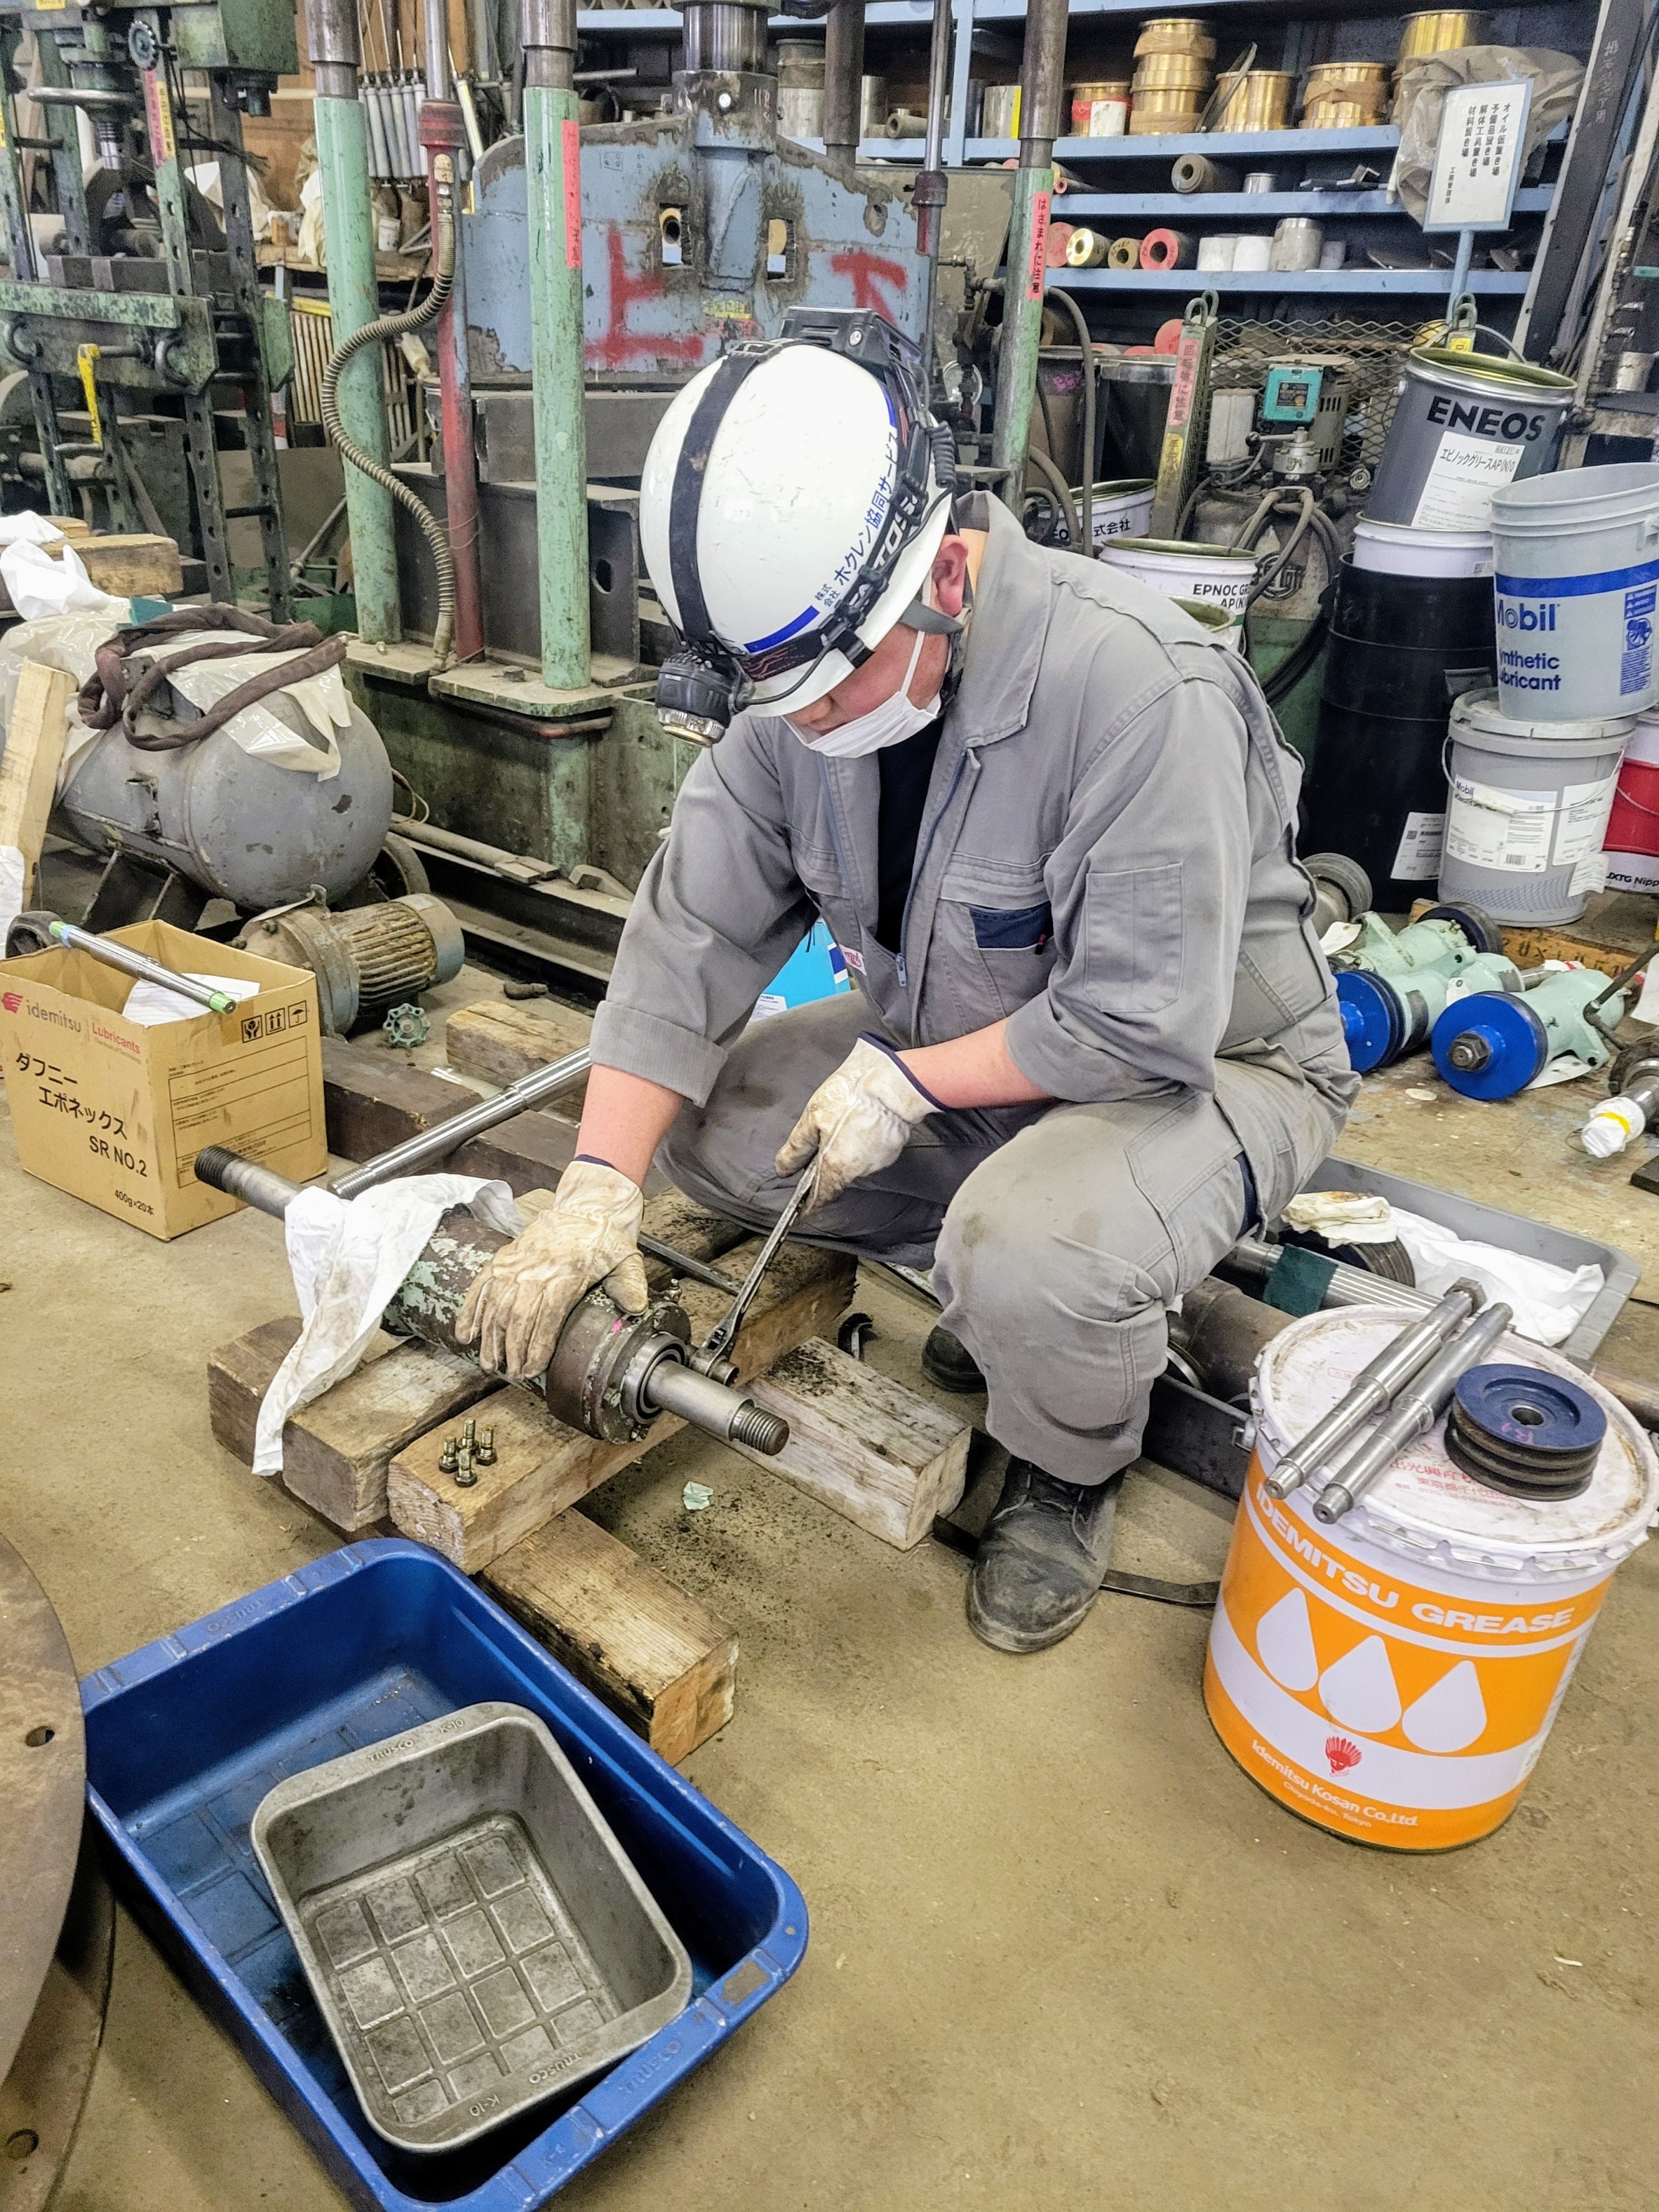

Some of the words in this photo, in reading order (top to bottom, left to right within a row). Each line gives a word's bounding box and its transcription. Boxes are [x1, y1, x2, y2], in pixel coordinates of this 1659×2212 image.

[1426, 396, 1545, 441] ENEOS
[1193, 584, 1238, 596] EPNOC
[1499, 650, 1559, 669] ynthetic
[1456, 780, 1474, 796] Mobil
[26, 1000, 81, 1033] idemitsu
[93, 1022, 140, 1054] Lubricants
[16, 1052, 78, 1085] ダフニー
[39, 1086, 127, 1140] エポネックス
[90, 1136, 110, 1158] SR
[114, 1146, 147, 1177] NO.2
[1256, 1482, 1400, 1608] IDEMITSU
[1412, 1603, 1575, 1634] GREASE
[368, 1738, 415, 1763] TRUSCO
[439, 1719, 464, 1734] K-10
[1252, 1739, 1310, 1790] Idemitsu
[1312, 1783, 1359, 1812] Kosan
[528, 2053, 581, 2084] TRUSCO
[469, 2095, 501, 2117] K-10
